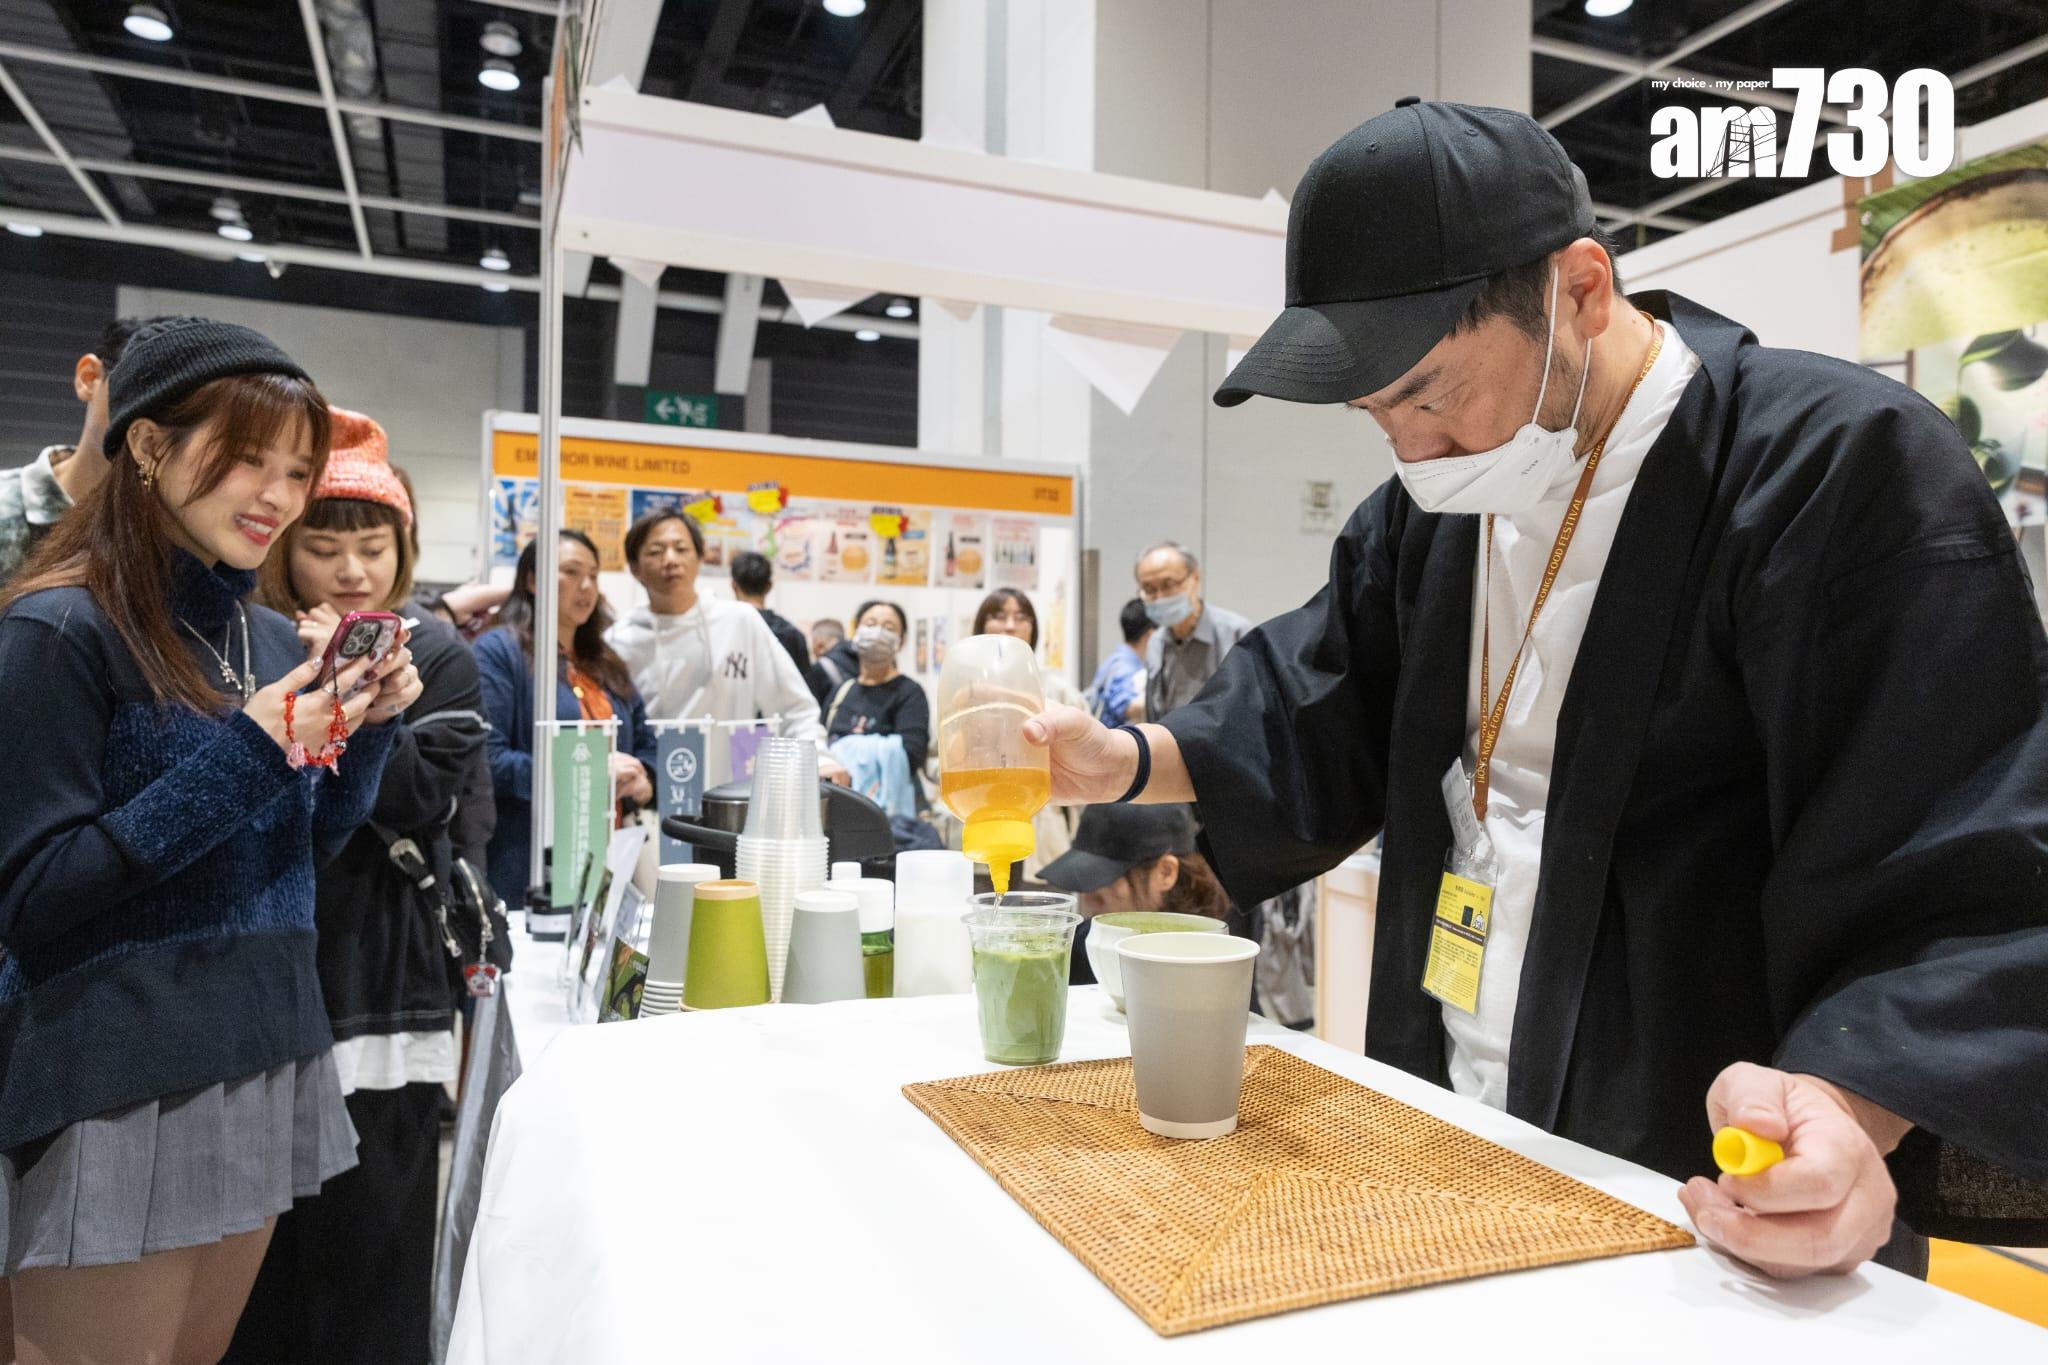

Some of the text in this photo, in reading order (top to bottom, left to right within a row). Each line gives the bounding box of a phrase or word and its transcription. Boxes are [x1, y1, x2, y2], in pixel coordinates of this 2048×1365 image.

[592, 453, 630, 470] WINE
[634, 457, 692, 475] LIMITED
[1537, 576, 1552, 606] KONG
[1550, 546, 1563, 575] FOOD
[1560, 497, 1584, 547] FESTIVAL
[1490, 703, 1504, 729] FOOD
[1482, 730, 1496, 753] KONG
[1477, 756, 1488, 784] HONG
